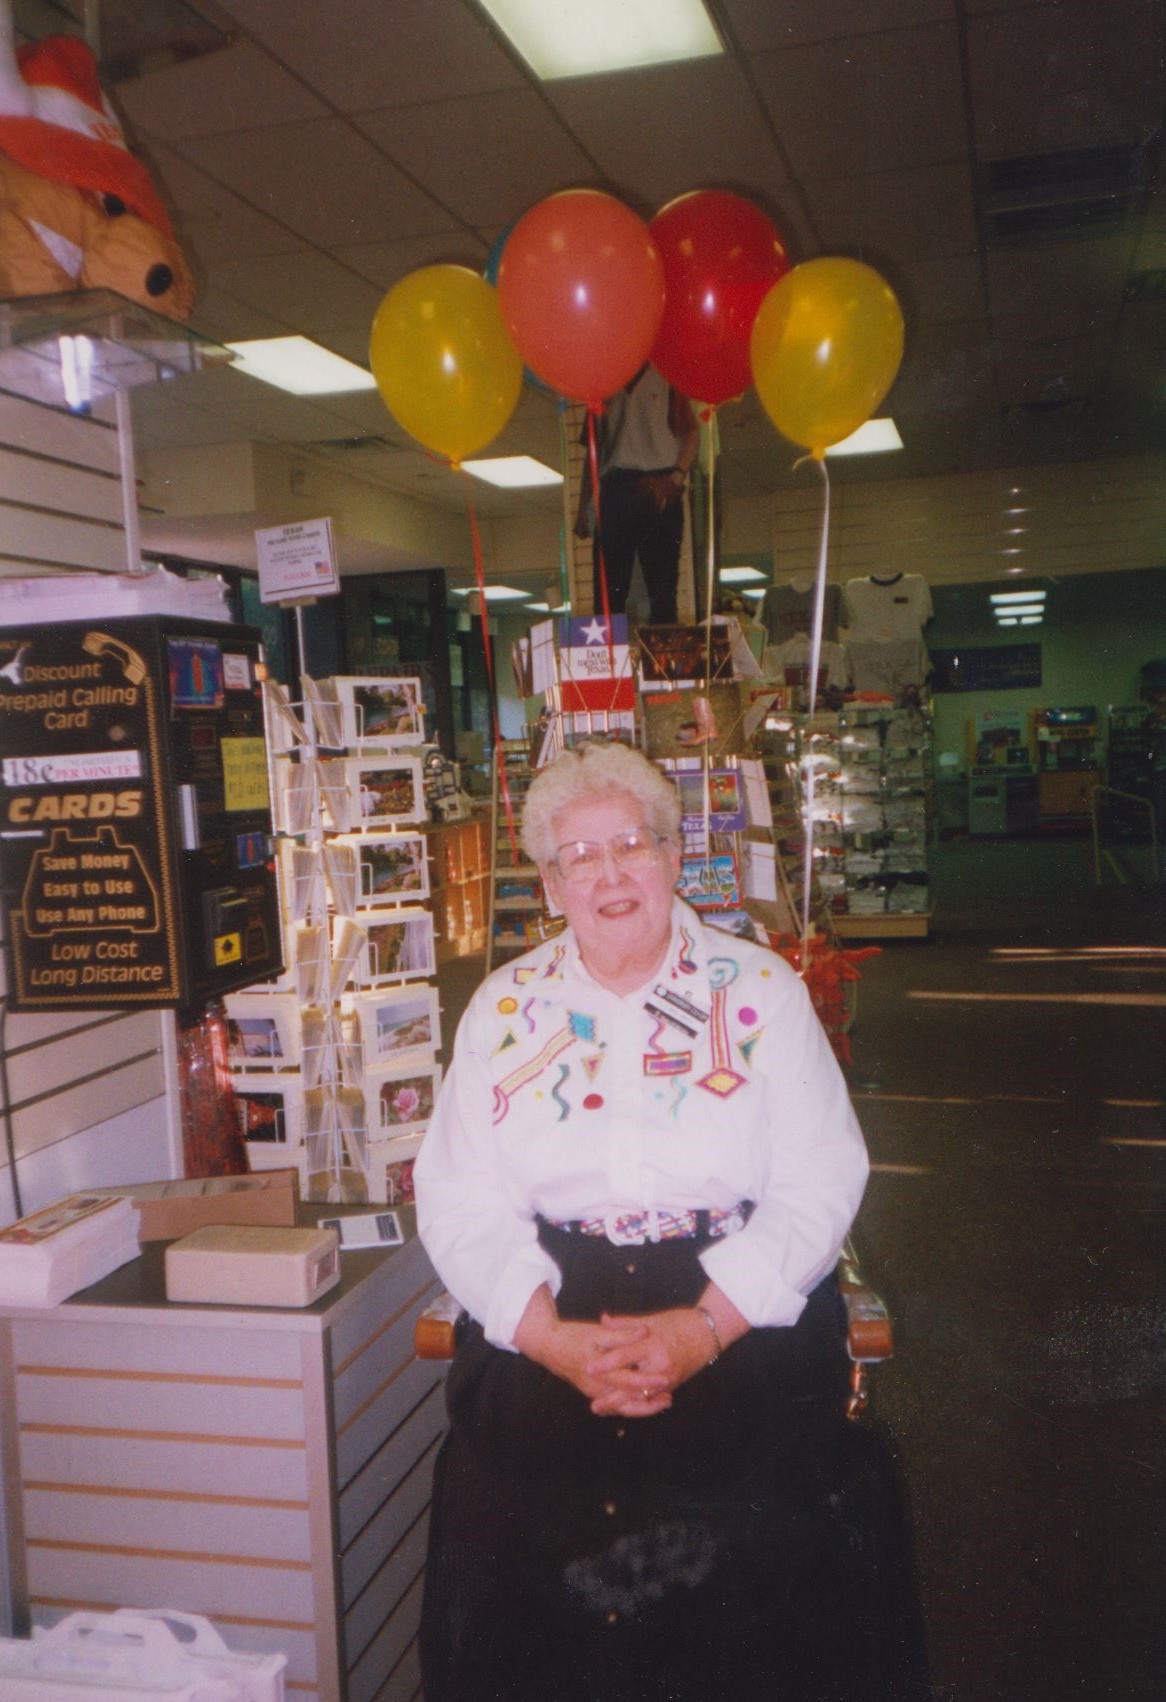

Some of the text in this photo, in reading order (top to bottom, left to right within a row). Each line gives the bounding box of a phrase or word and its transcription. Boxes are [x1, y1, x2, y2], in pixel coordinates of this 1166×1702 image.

[24, 664, 101, 682] Discount
[72, 686, 138, 706] Calling
[44, 709, 89, 730] Card
[55, 768, 79, 779] PER
[9, 791, 141, 822] CARDS
[42, 854, 129, 871] Save Money
[43, 879, 134, 898] Easy to Use
[36, 905, 146, 924] Use Any Phone
[51, 940, 139, 961] Low Cost
[31, 965, 163, 986] Long Distance
